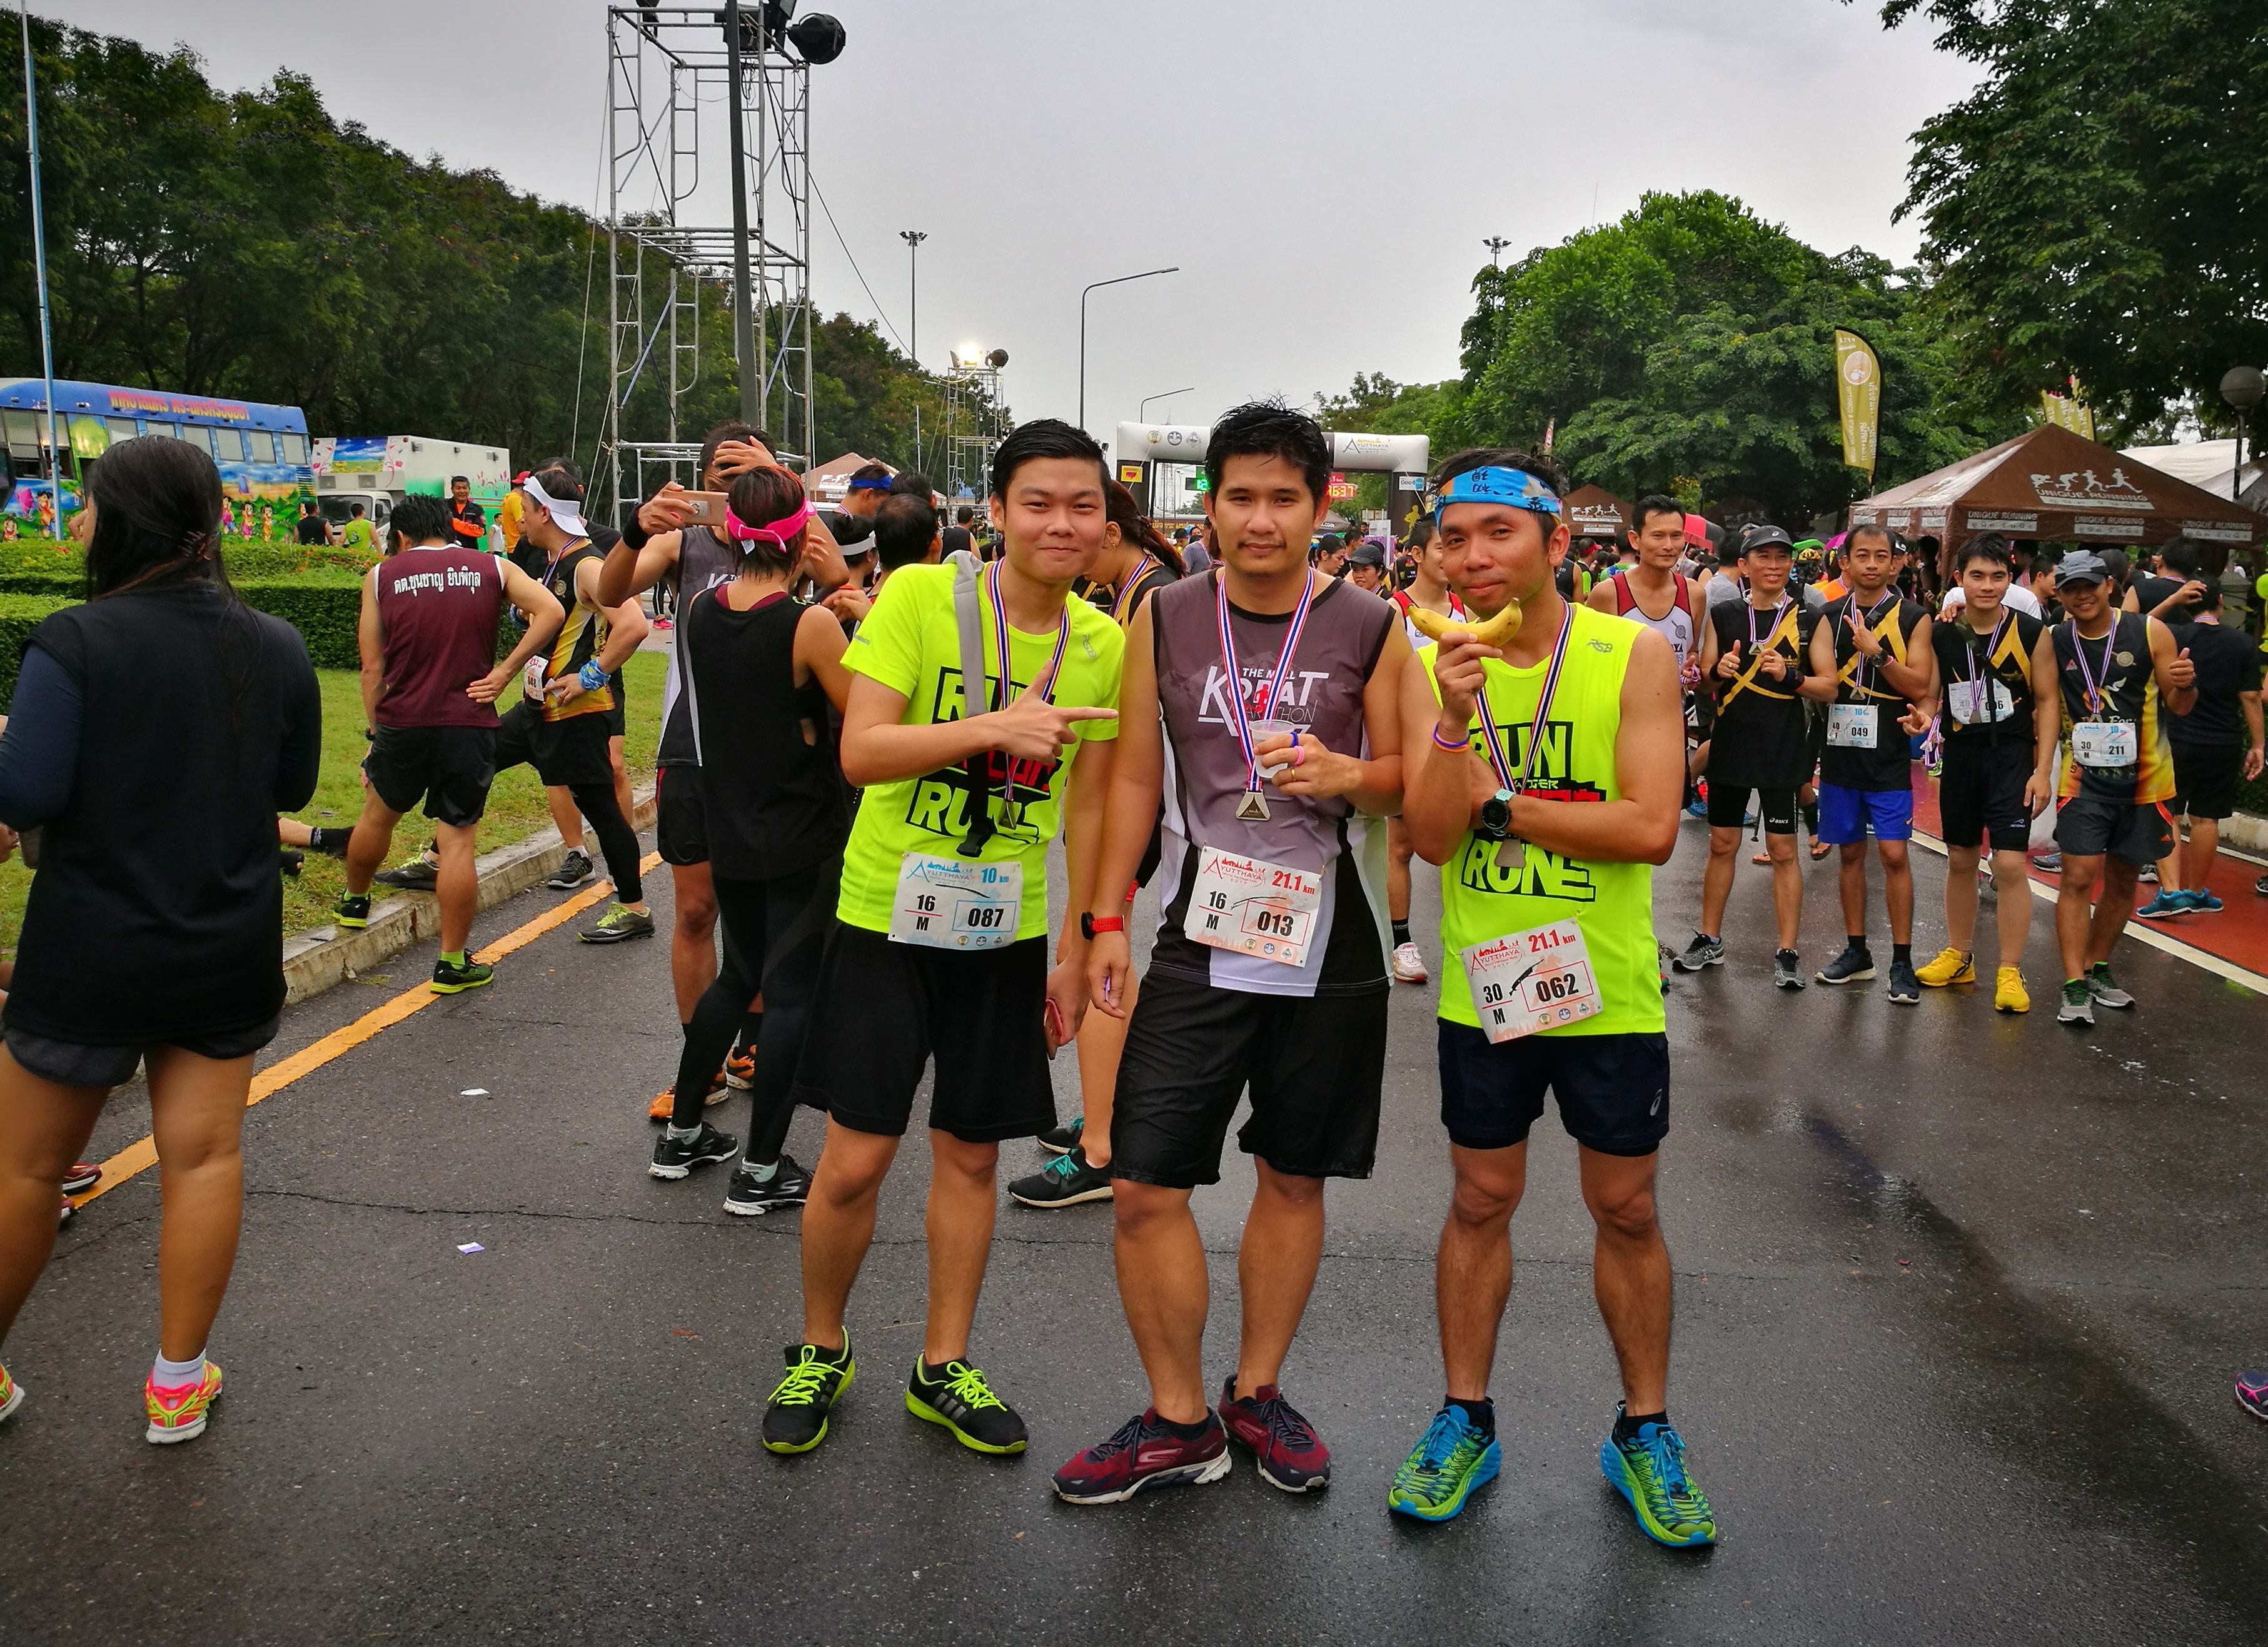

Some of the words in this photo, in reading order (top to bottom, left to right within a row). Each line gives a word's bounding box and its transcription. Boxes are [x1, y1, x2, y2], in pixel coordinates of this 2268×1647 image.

[2036, 489, 2085, 498] UNIQUE
[2090, 492, 2149, 501] RUNNING
[1968, 511, 1999, 519] UNIQUE
[2002, 512, 2038, 520] RUNNING
[2107, 516, 2144, 525] RUNNING
[1242, 668, 1264, 678] THE
[1266, 669, 1295, 680] MLL
[1228, 699, 1318, 723] ARTHON
[1852, 727, 1868, 737] 049
[2081, 741, 2091, 749] 30
[2109, 745, 2124, 755] 211
[981, 868, 997, 884] 10
[1272, 870, 1303, 891] 21.1
[1303, 885, 1315, 895] km
[917, 895, 936, 912] 16
[1209, 891, 1227, 910] 16
[916, 916, 930, 931] M
[967, 908, 1004, 927] 087
[1206, 914, 1219, 930] M
[1257, 911, 1294, 937] 013
[1528, 929, 1560, 953] 21.1
[1562, 934, 1576, 945] km
[1483, 983, 1503, 1004] 30
[1536, 973, 1579, 1002] 062
[1493, 1007, 1506, 1025] M
